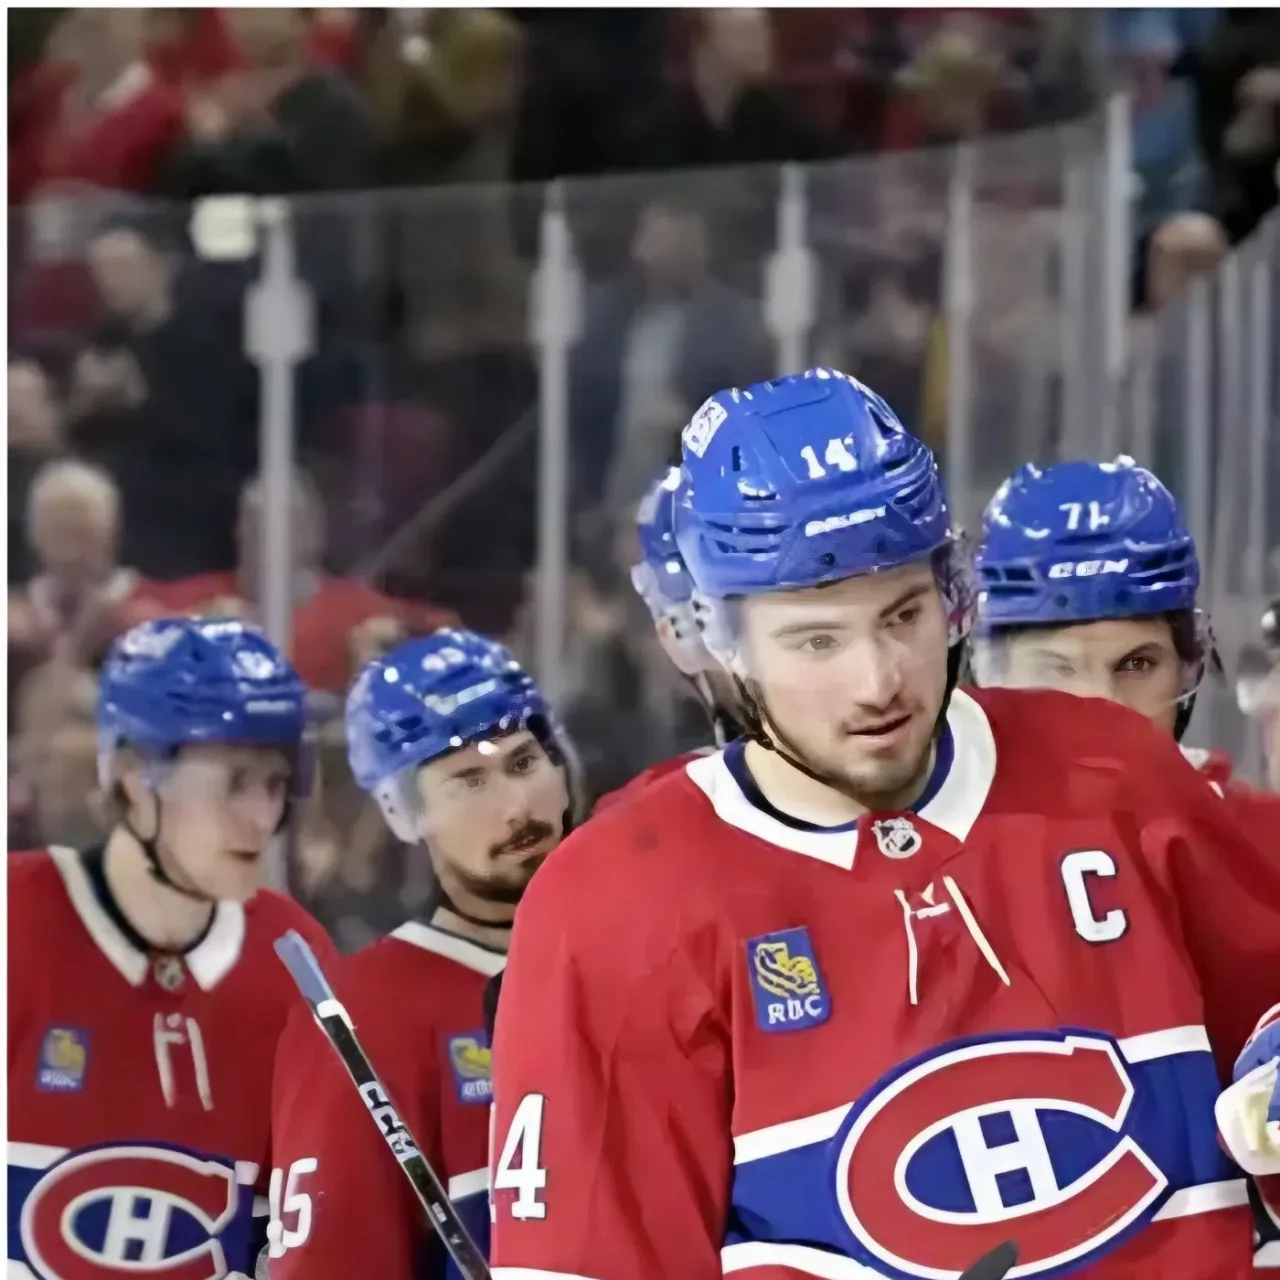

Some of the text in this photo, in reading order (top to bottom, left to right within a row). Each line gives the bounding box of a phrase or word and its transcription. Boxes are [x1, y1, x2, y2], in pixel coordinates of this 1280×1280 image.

[800, 437, 858, 480] 14
[1060, 850, 1128, 942] C
[488, 1092, 547, 1220] 4
